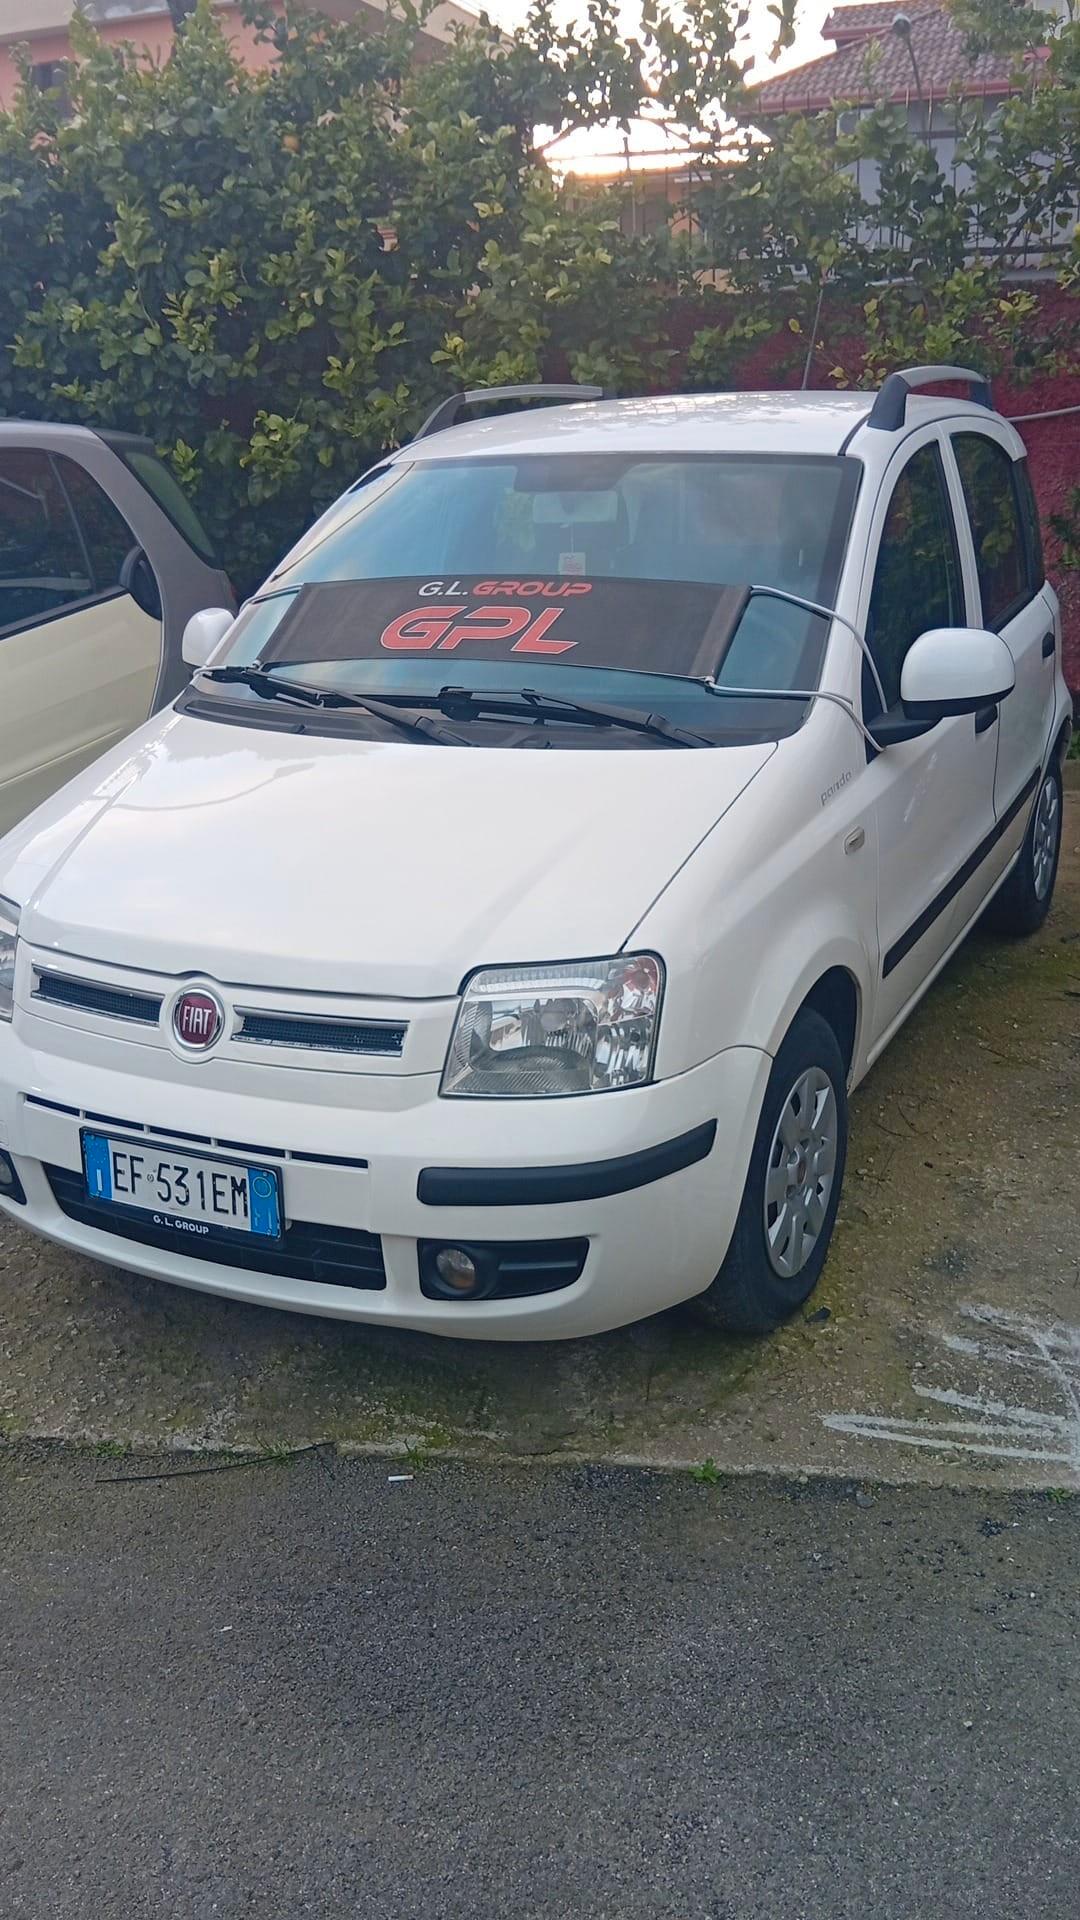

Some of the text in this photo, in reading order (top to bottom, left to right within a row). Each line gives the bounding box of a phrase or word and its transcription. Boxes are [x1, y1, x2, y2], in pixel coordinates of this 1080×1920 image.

[418, 581, 593, 597] G.L. GROUP
[380, 605, 579, 655] GPL
[820, 771, 852, 806] panda
[182, 1005, 212, 1035] FIAT
[112, 1151, 249, 1217] EF 531EM
[175, 1220, 209, 1235] GROUP
